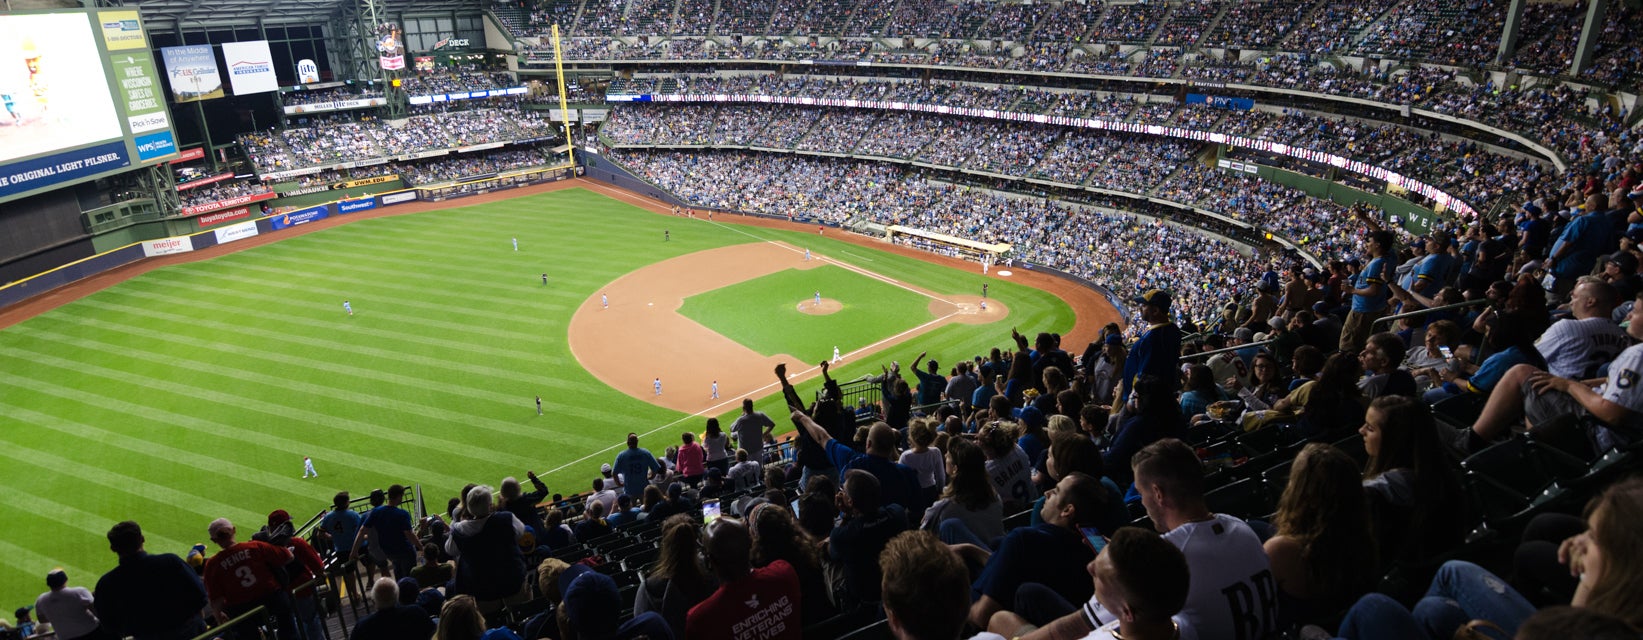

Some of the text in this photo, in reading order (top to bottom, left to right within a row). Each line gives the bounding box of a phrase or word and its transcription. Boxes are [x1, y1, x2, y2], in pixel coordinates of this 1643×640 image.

[448, 38, 470, 46] DECK
[186, 46, 208, 54] Middle
[178, 55, 210, 63] Anywhere
[124, 66, 144, 78] WHERE
[300, 64, 315, 76] Lite
[122, 76, 152, 89] WISCONSIN
[128, 87, 154, 100] SAVES ON
[138, 142, 154, 152] WPS
[10, 167, 55, 184] ORIGINAL
[56, 160, 83, 174] LIGHT
[85, 152, 120, 167] PILSNER.
[194, 196, 252, 212] TOYOTA TERRITORY
[341, 202, 369, 211] Southwest
[200, 208, 248, 223] buyatoyota.com
[153, 240, 181, 249] meijer
[1234, 360, 1248, 377] 8
[994, 459, 1023, 486] BRAUN
[220, 549, 252, 570] PENCE
[235, 565, 256, 588] 3
[732, 595, 789, 634] ENRICHING
